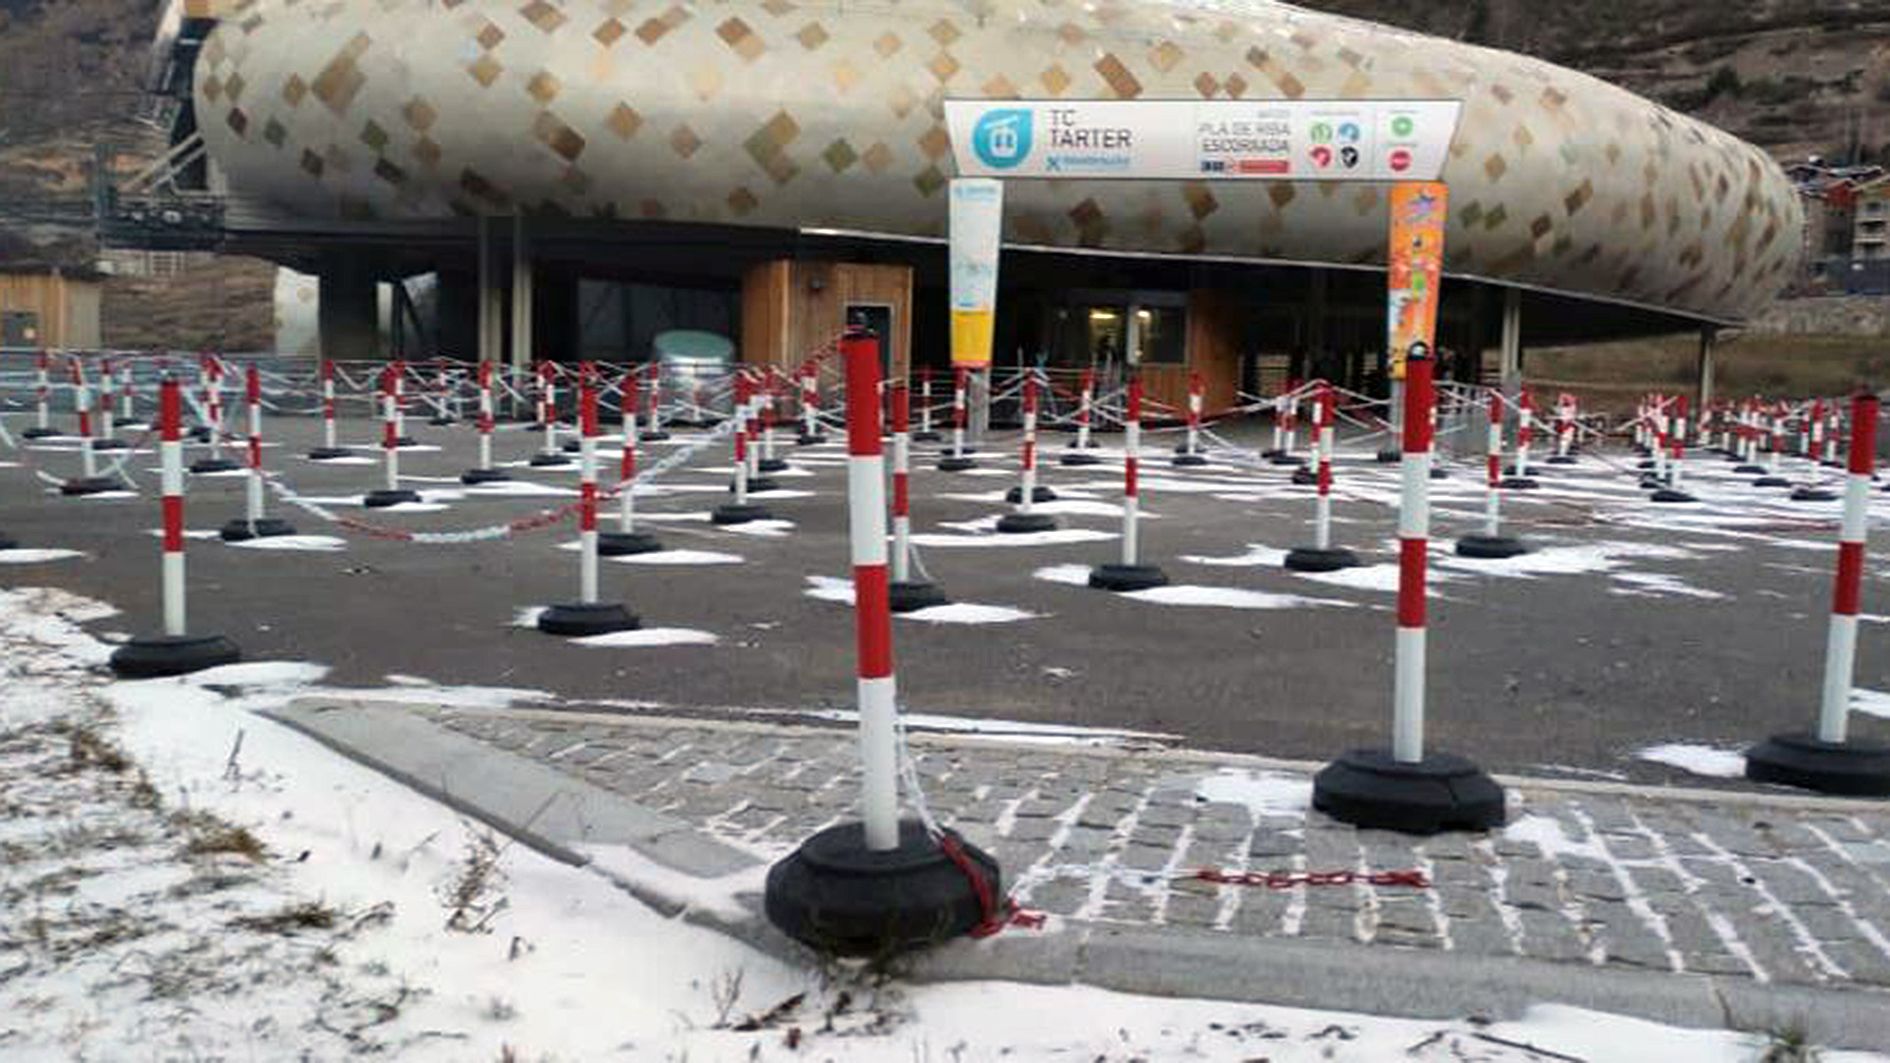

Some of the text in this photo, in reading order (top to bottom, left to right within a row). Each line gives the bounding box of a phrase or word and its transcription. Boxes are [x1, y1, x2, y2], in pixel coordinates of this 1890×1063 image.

[1050, 109, 1075, 126] TC
[1233, 122, 1252, 135] DE
[1051, 129, 1132, 148] TARTER
